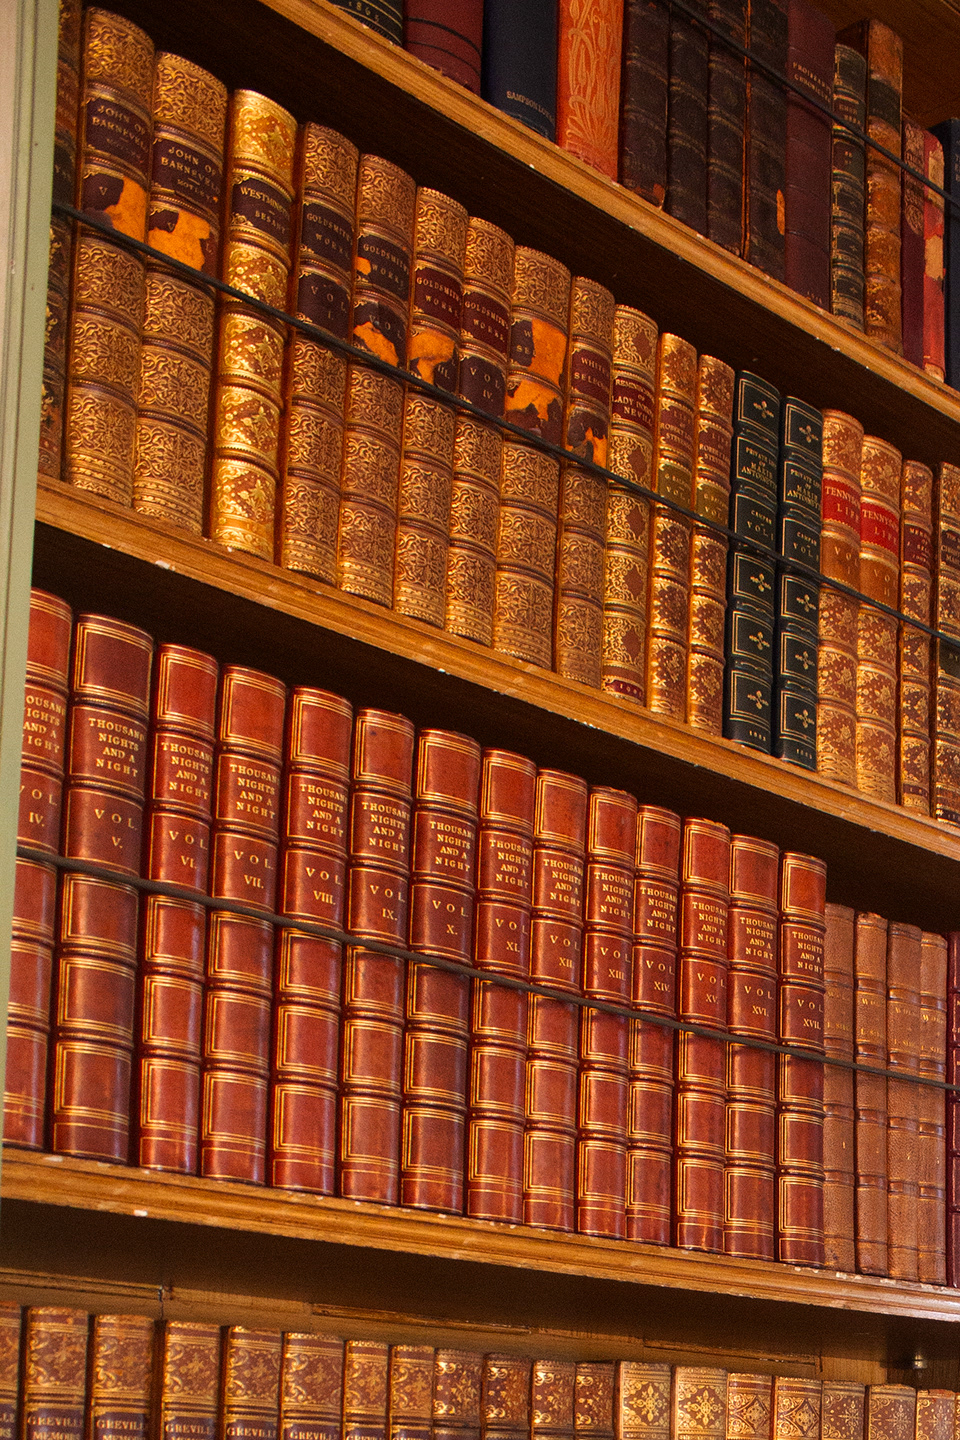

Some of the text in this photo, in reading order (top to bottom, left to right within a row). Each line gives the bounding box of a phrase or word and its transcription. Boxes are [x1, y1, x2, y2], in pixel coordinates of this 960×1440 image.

[98, 105, 146, 135] JOHN OF
[92, 116, 148, 150] BARNEVEL
[168, 147, 199, 165] JOHN
[99, 733, 139, 751] NIGHTS
[102, 747, 135, 763] AND A
[161, 742, 213, 765] THOUSAN
[96, 759, 139, 777] NIGHT
[171, 756, 209, 774] NIGHTS
[176, 770, 206, 785] AND A
[229, 764, 279, 785] THOUSAN
[169, 782, 209, 800] NIGHT
[237, 777, 276, 795] NIGHTS
[300, 784, 347, 803] THOUSAN
[240, 791, 263, 802] AND
[236, 802, 275, 819] NIGHT
[308, 796, 344, 813] NIGHTS
[361, 802, 410, 821] THOUSAN
[312, 810, 332, 821] AND
[370, 814, 406, 830] NIGHTS
[306, 821, 344, 837] NIGHT
[373, 826, 404, 841] AND A
[430, 821, 475, 838] THOUSAN
[112, 836, 123, 849] V.
[369, 838, 406, 853] NIGHT
[437, 834, 471, 849] NIGHTS
[489, 839, 531, 856] THOUSAN
[440, 846, 468, 860] AND A
[497, 852, 529, 867] NIGHTS
[181, 856, 197, 869] VI.
[435, 857, 470, 872] NIGHT
[500, 864, 526, 877] AND A
[244, 875, 264, 889] VII.
[495, 874, 528, 889] NIGHT
[313, 891, 336, 905] VIII.
[640, 887, 677, 901] THOUSAN
[648, 898, 676, 912] NIGHTS
[382, 908, 398, 920] IX.
[651, 909, 674, 922] AND A
[446, 924, 458, 935] X.
[646, 919, 676, 933] NIGHT
[653, 981, 671, 992] XIV.
[28, 1416, 82, 1428] GREVILL
[96, 1419, 146, 1431] GREVILL
[165, 1424, 213, 1435] GREVILL
